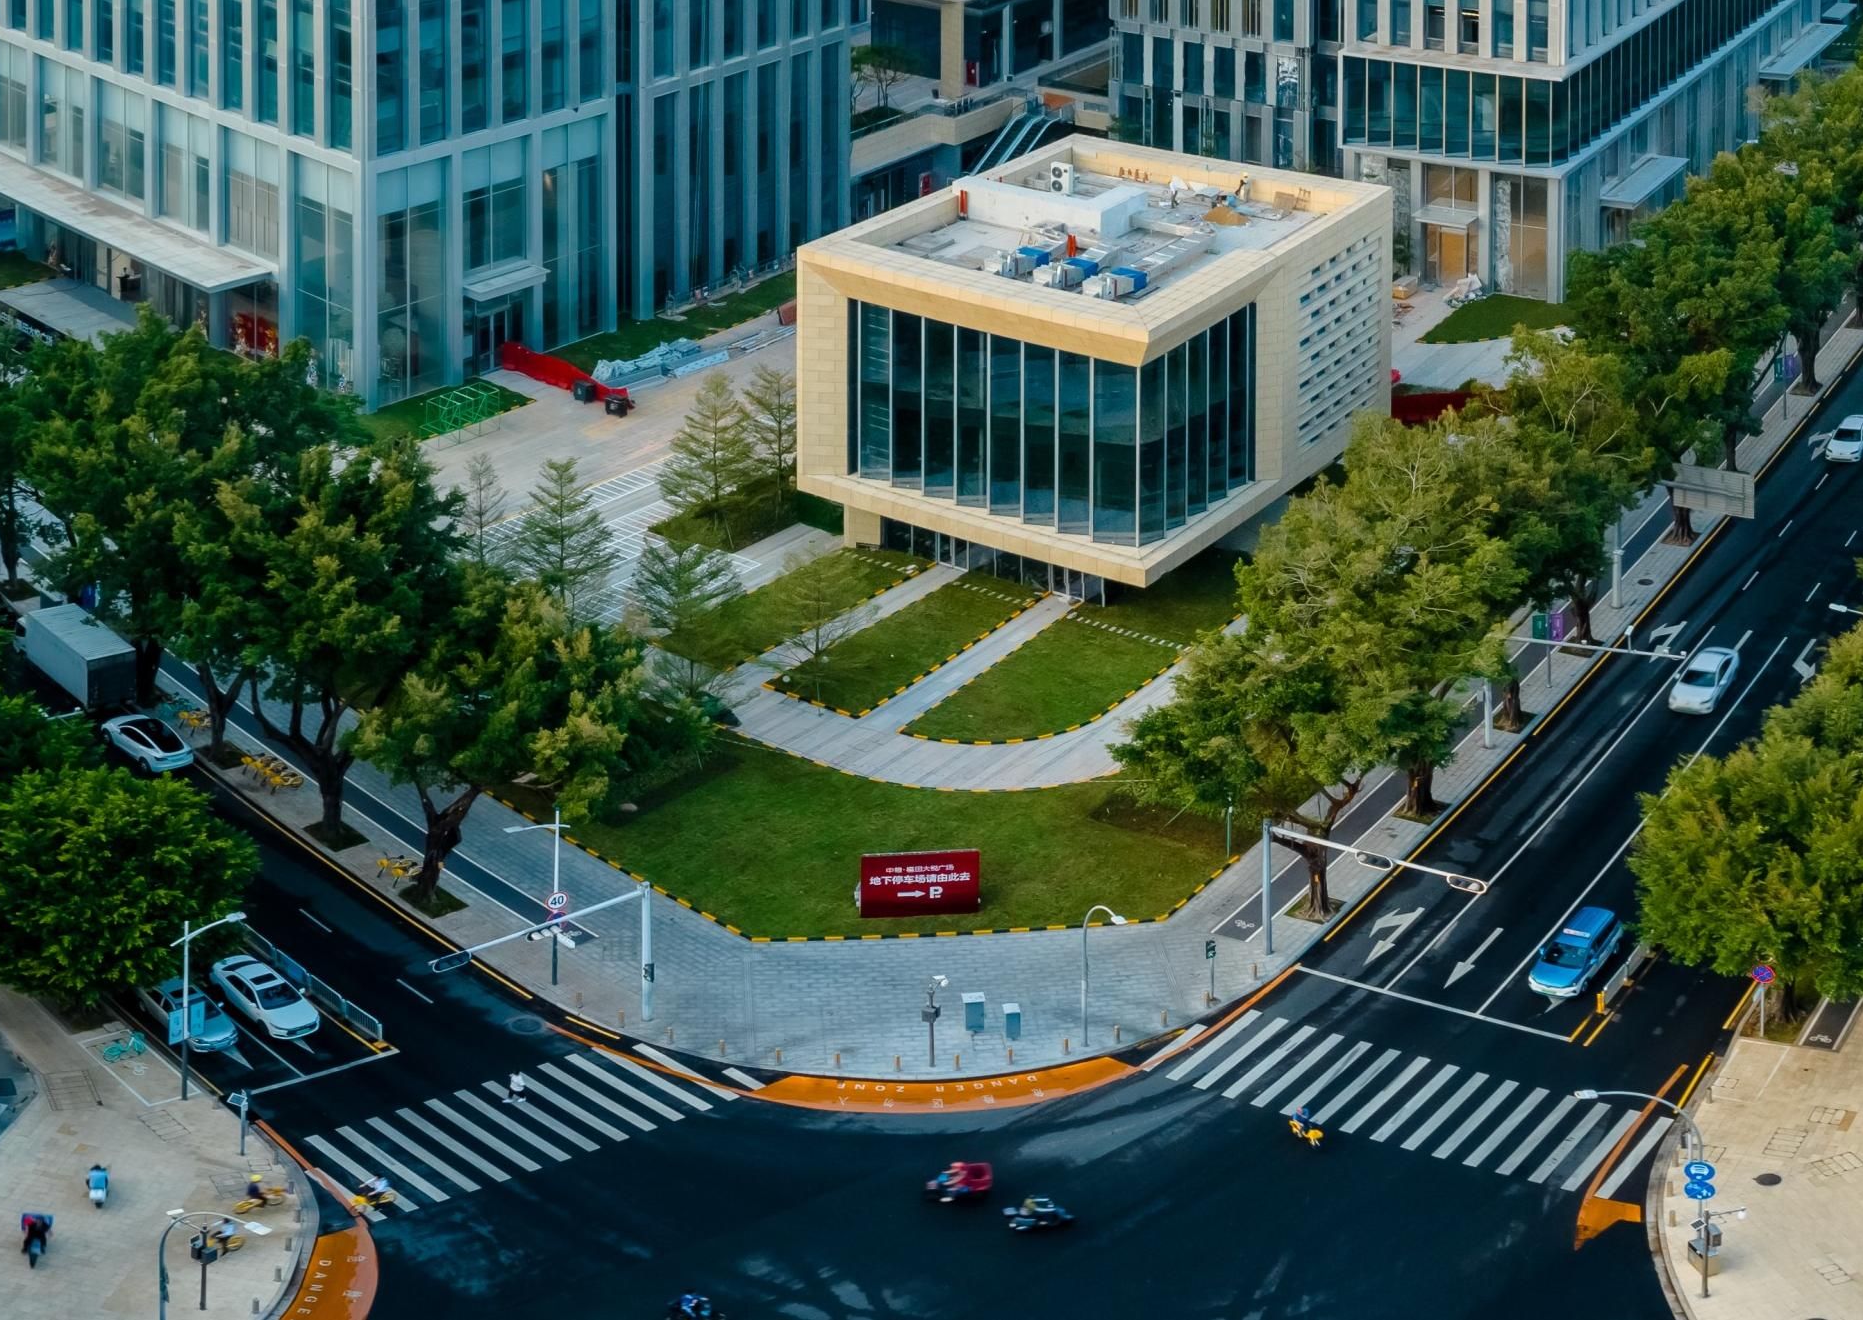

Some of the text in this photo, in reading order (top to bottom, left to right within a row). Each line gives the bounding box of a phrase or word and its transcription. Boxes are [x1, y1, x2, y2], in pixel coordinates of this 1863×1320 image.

[869, 871, 971, 886] 地下停车场请由此去
[550, 895, 564, 906] 40
[936, 1075, 1037, 1093] DANGER
